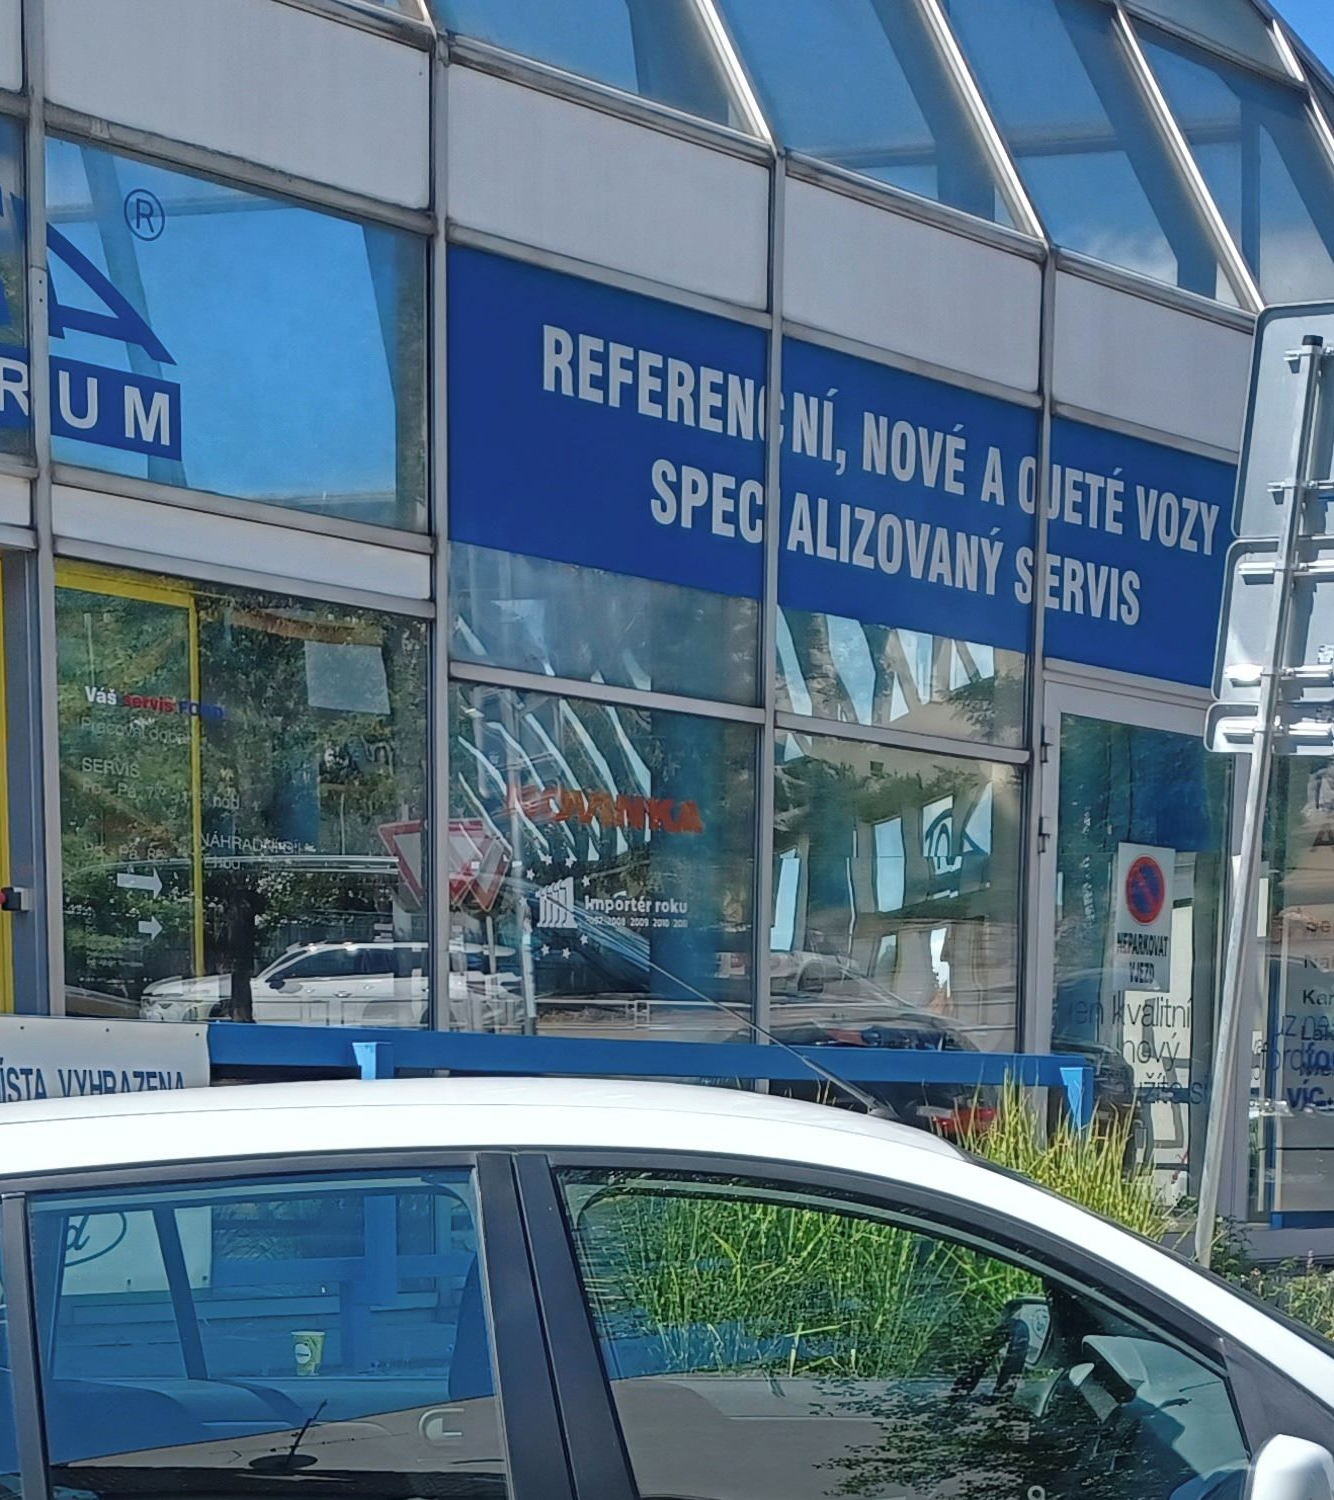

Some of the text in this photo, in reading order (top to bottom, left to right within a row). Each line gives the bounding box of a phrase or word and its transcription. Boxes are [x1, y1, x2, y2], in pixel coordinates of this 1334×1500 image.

[862, 411, 966, 496] NOVÉ
[981, 448, 1006, 507] A
[1018, 456, 1125, 536] OJETÉ
[1135, 485, 1221, 557] VOZY
[650, 459, 1142, 626] SPECALIZOVANÝ SERVIS
[85, 686, 117, 705] Váš
[81, 757, 140, 778] SERVIS
[655, 896, 688, 914] roku
[1129, 962, 1155, 984] VJEZD
[1112, 991, 1193, 1029] kvalitní
[1123, 1032, 1181, 1073] nový
[57, 1069, 186, 1098] VYHRAZENA
